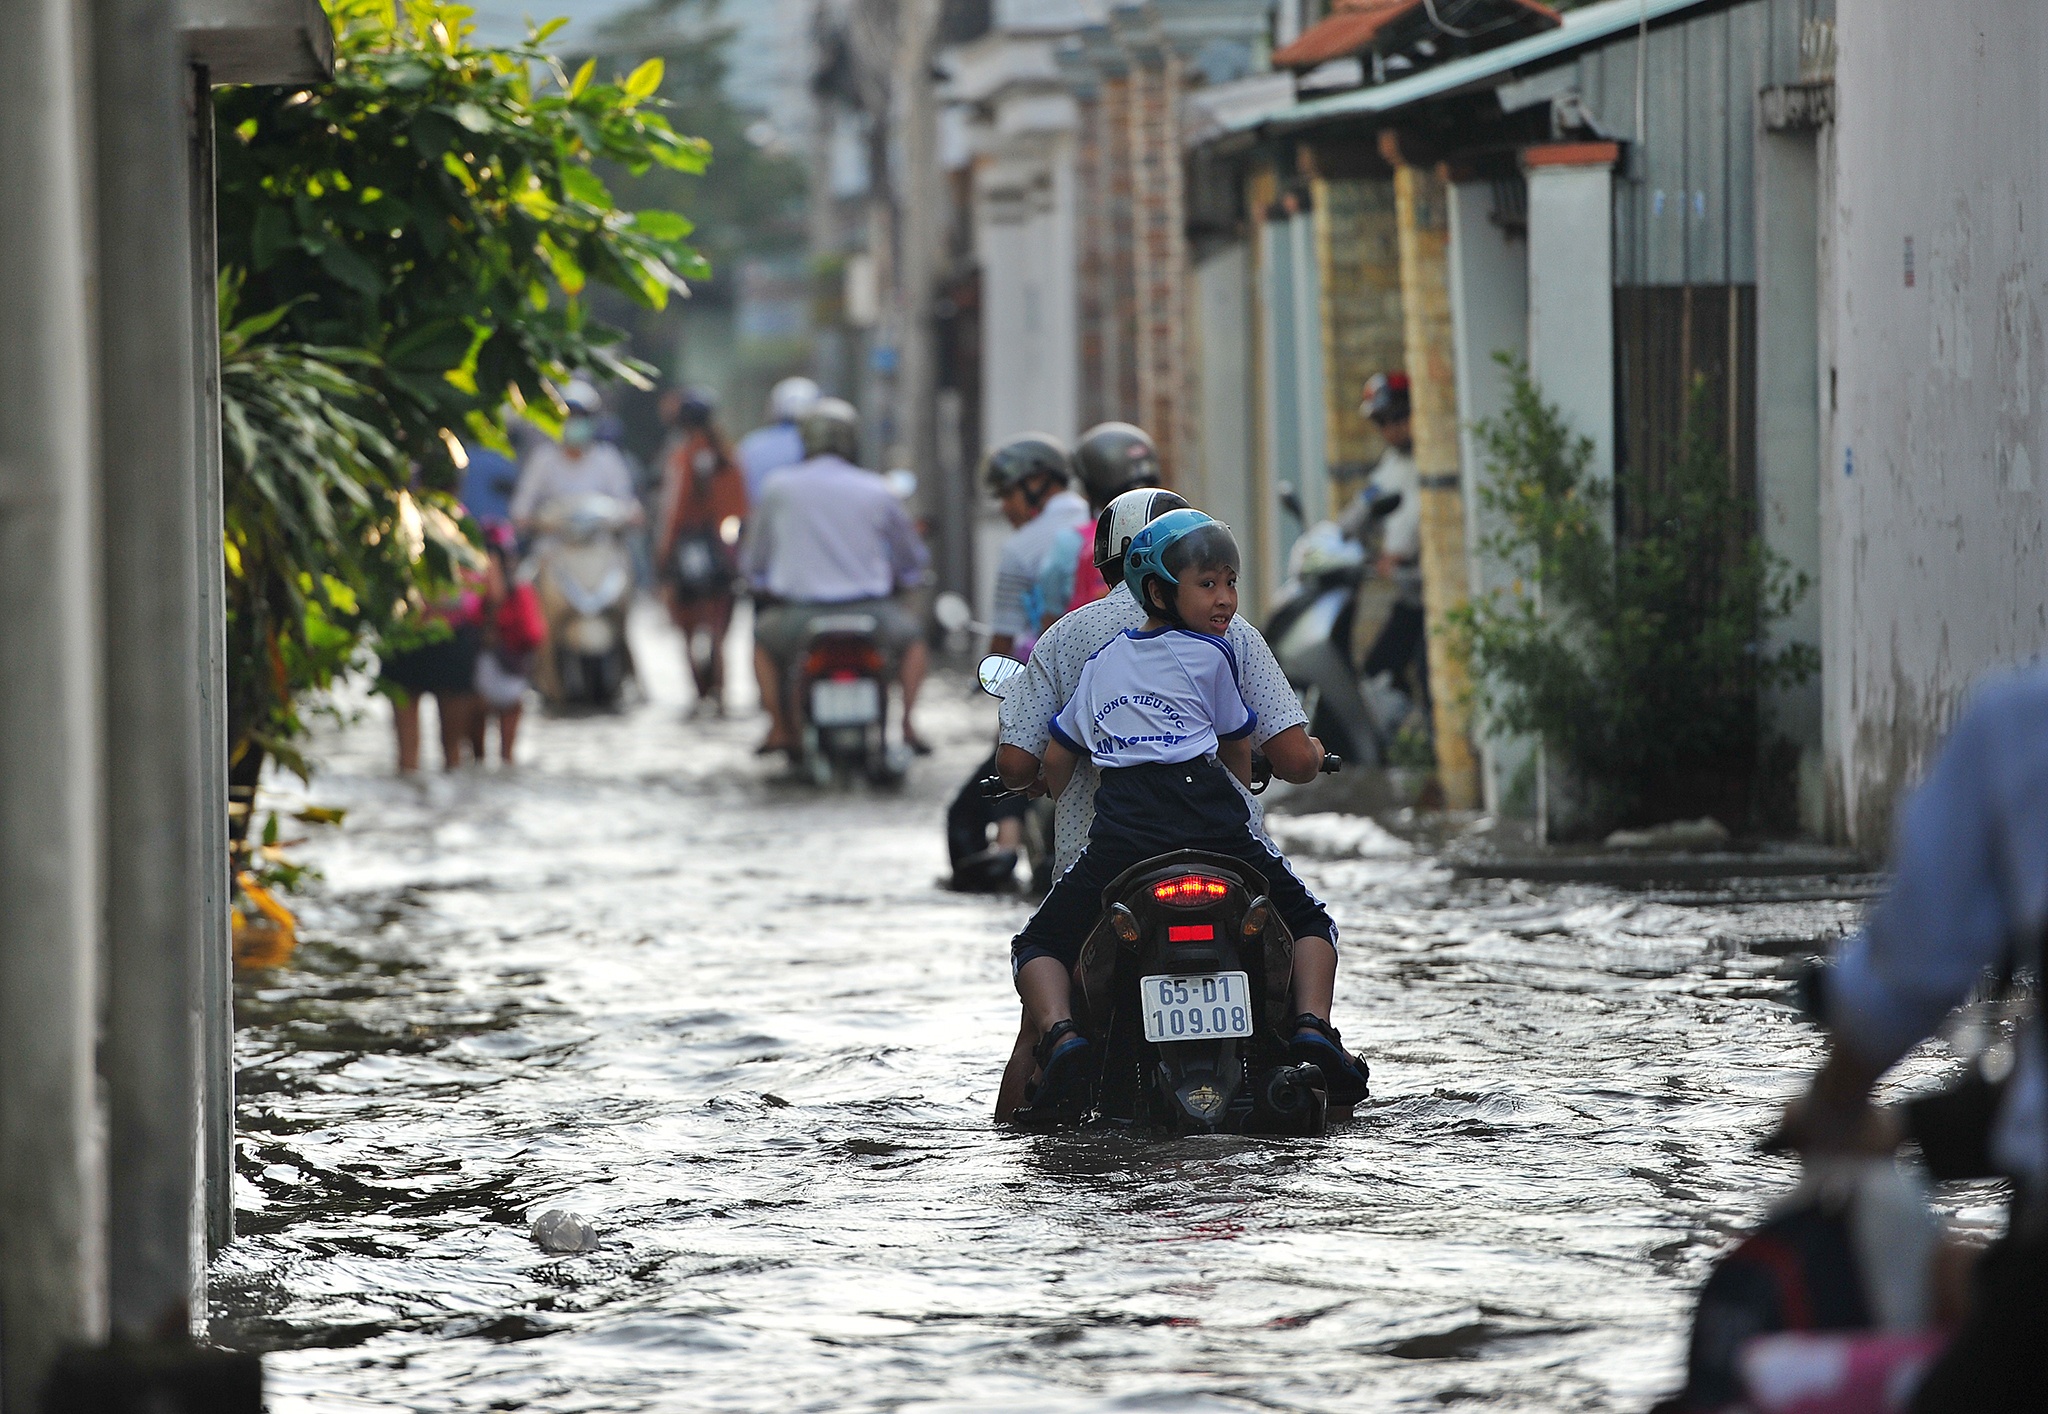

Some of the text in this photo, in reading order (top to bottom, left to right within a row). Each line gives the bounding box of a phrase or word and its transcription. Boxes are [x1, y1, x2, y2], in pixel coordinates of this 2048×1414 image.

[1132, 691, 1163, 709] TIỂU
[1162, 704, 1185, 729] HỌC
[1159, 977, 1231, 1006] 65-D1
[1152, 1006, 1245, 1037] 109.08
